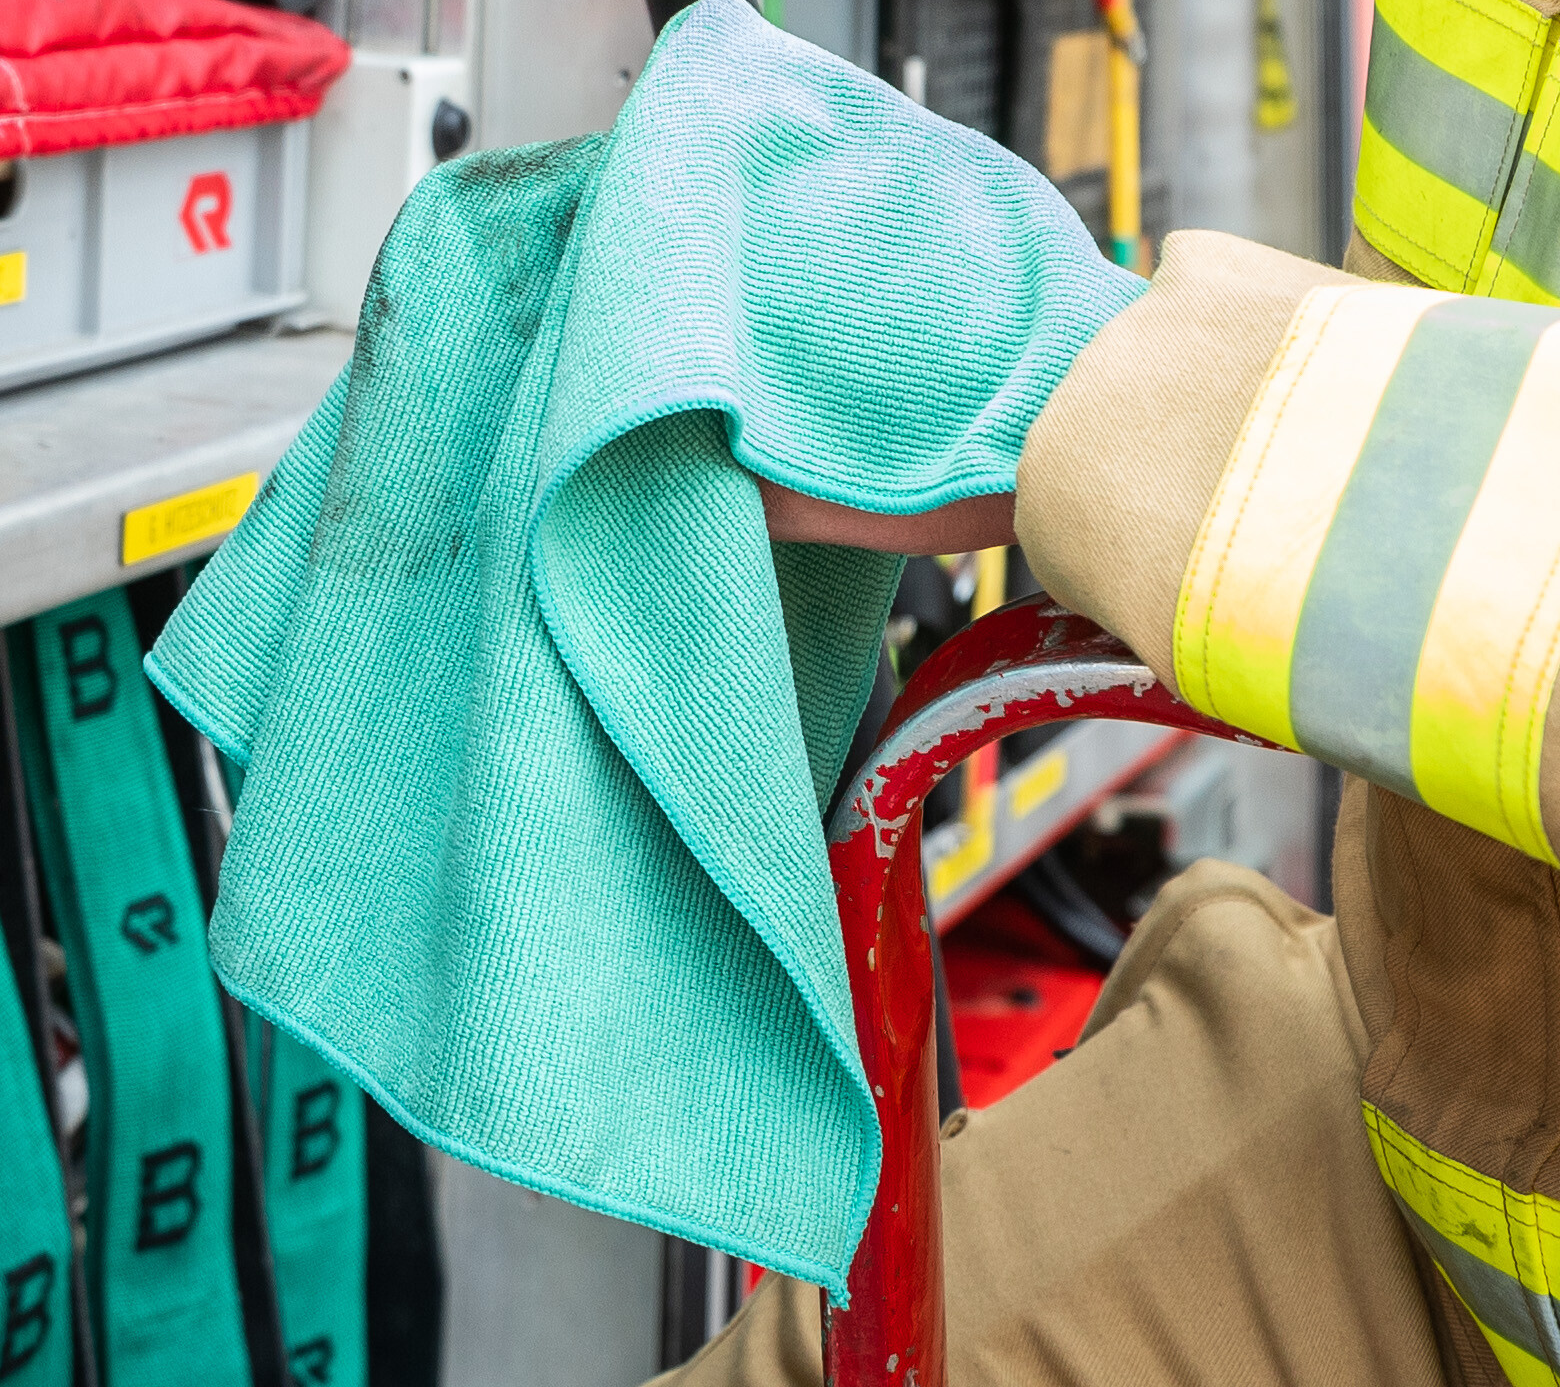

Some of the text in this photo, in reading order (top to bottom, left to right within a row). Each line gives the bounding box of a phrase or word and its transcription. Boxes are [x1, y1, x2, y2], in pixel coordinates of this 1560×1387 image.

[56, 614, 120, 722] B
[289, 1079, 343, 1183] B
[134, 1140, 201, 1252] B
